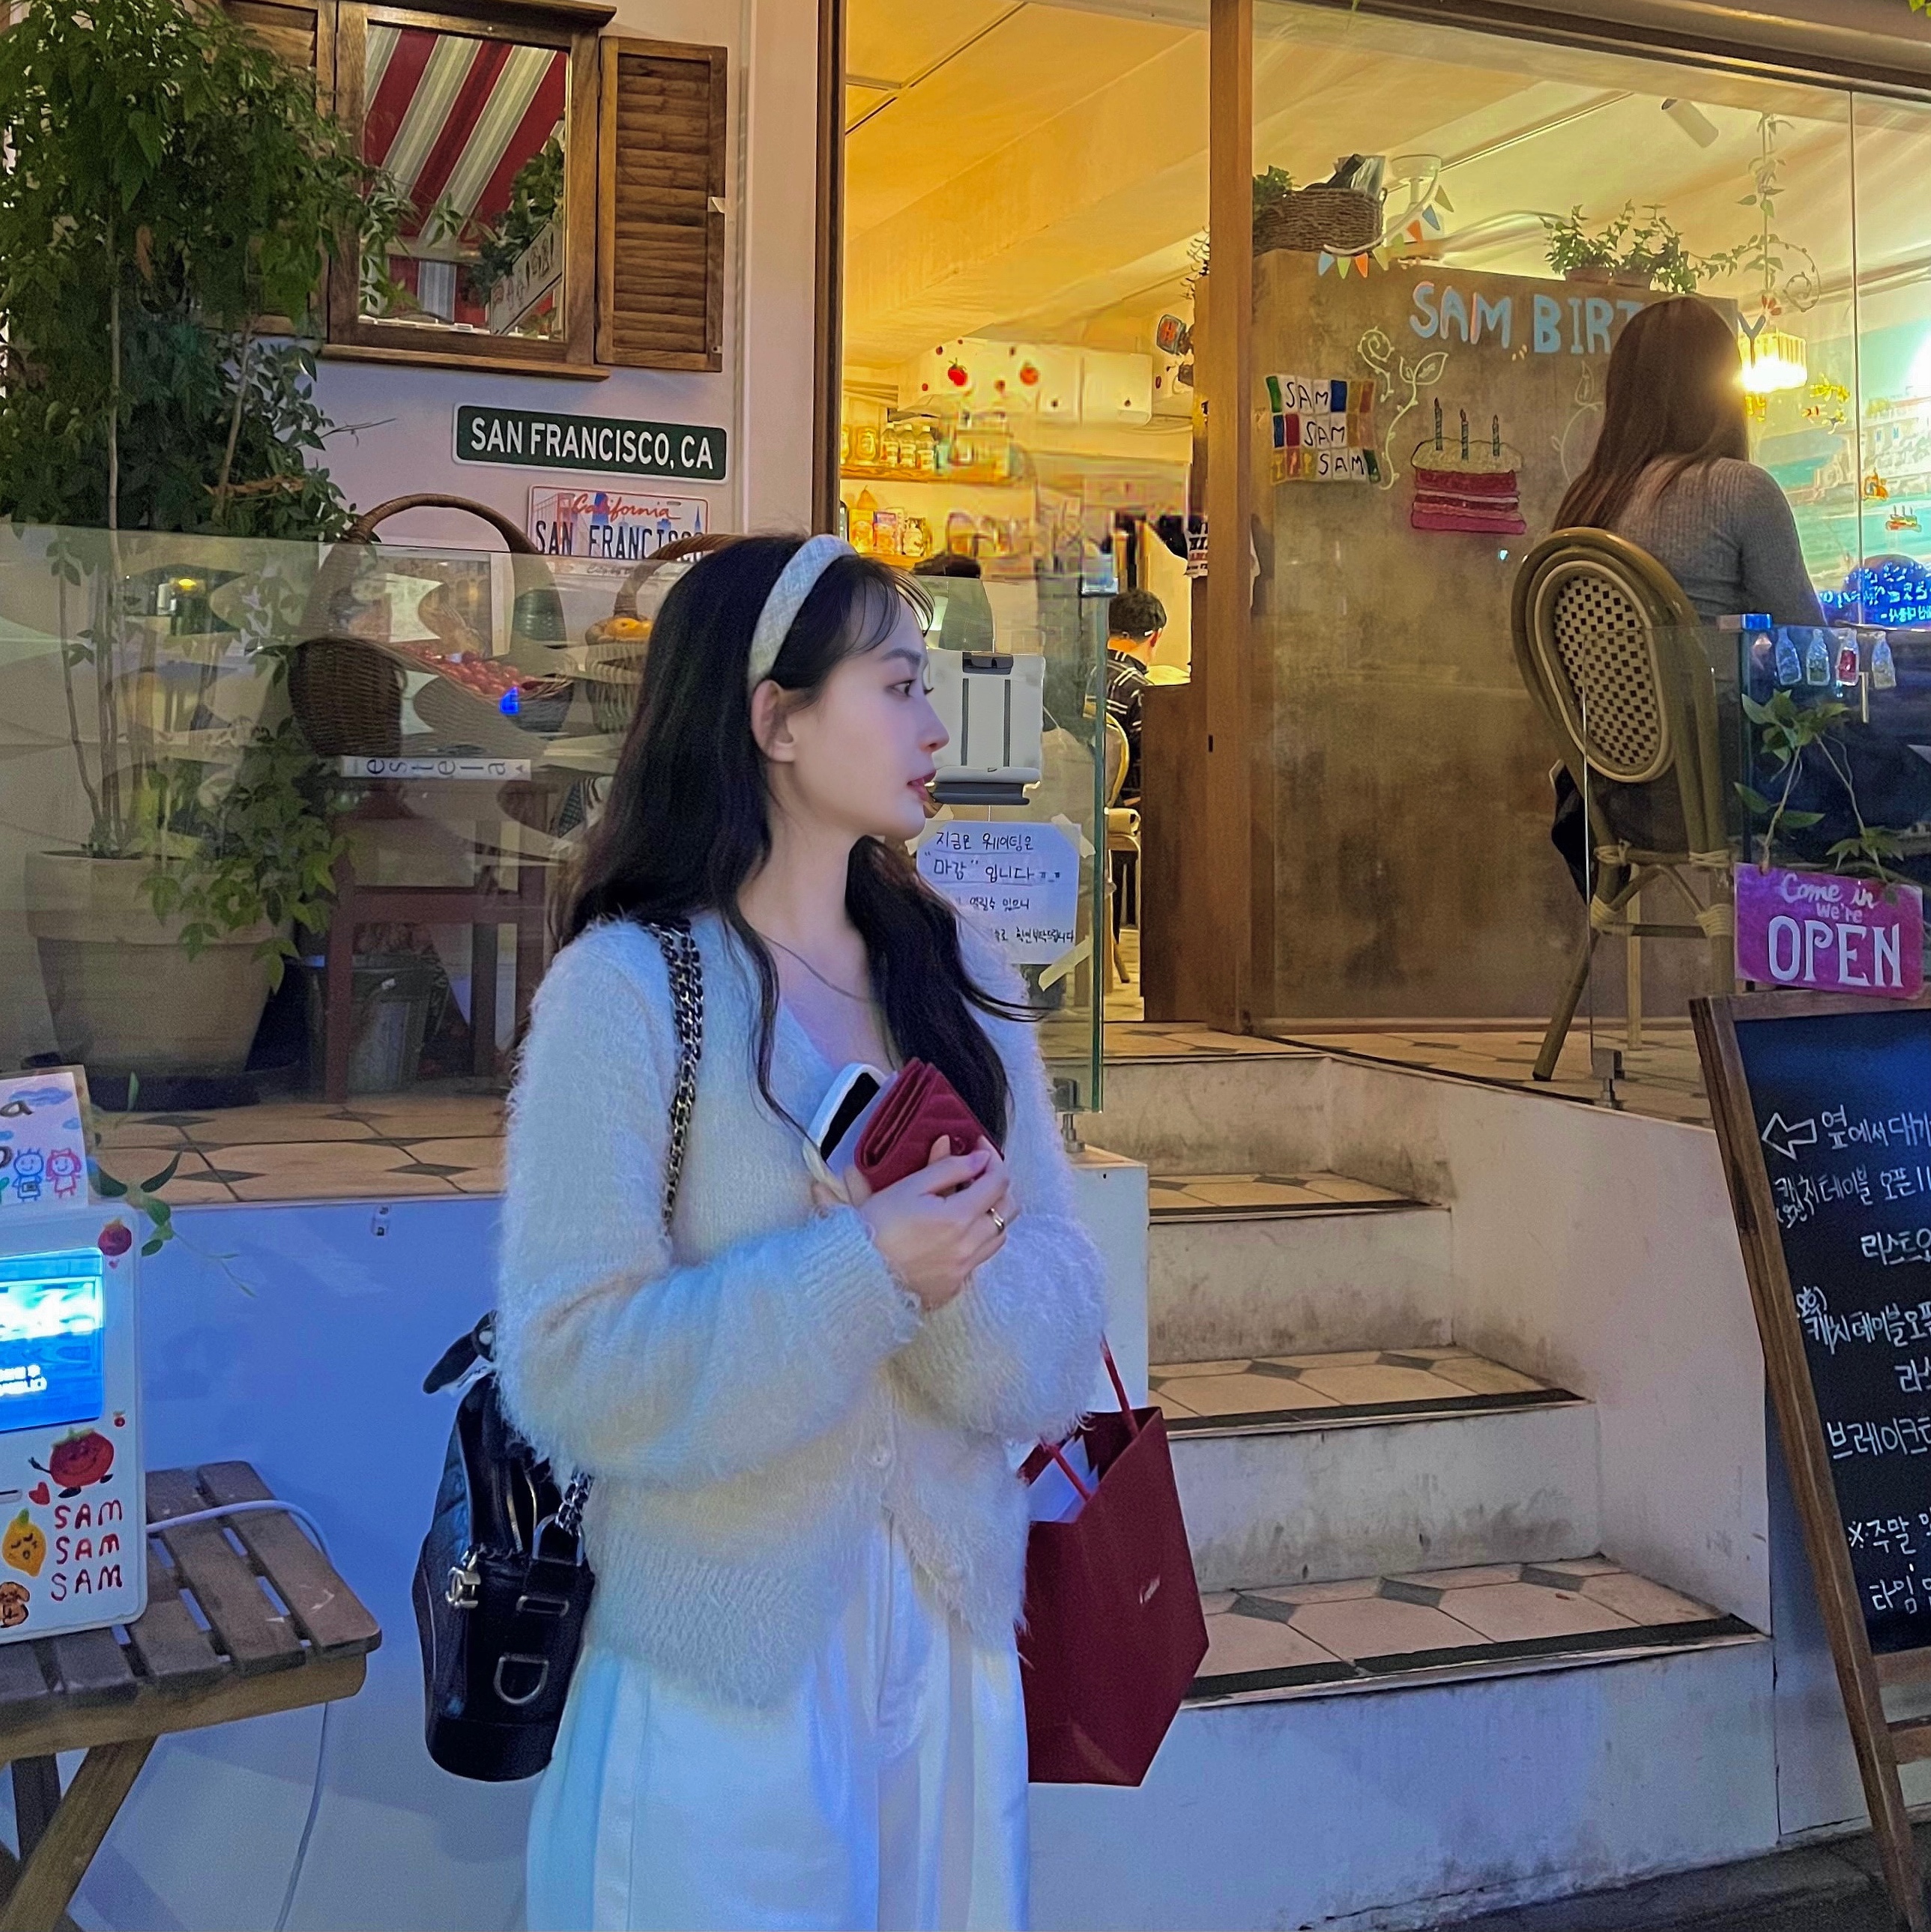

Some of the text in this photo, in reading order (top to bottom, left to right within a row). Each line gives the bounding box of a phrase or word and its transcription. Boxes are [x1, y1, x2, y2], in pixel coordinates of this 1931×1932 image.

[1409, 281, 1511, 349] SAM
[1286, 382, 1329, 408] SAM
[471, 417, 713, 470] SAN FRANCISCO, CA
[1305, 421, 1345, 446] SAM
[1318, 453, 1364, 475] SAM
[572, 492, 681, 523] California
[535, 520, 574, 555] SAN
[937, 832, 1034, 851] 지금은 웨이팅은
[985, 864, 1035, 883] 입니다
[1781, 873, 1879, 909] Come in
[1768, 915, 1905, 988] OPEN
[1880, 1166, 1916, 1200] 오픈
[55, 1500, 123, 1530] SAM
[55, 1533, 120, 1565] SAM
[51, 1564, 123, 1602] SAM
[1870, 1575, 1917, 1614] 타임
